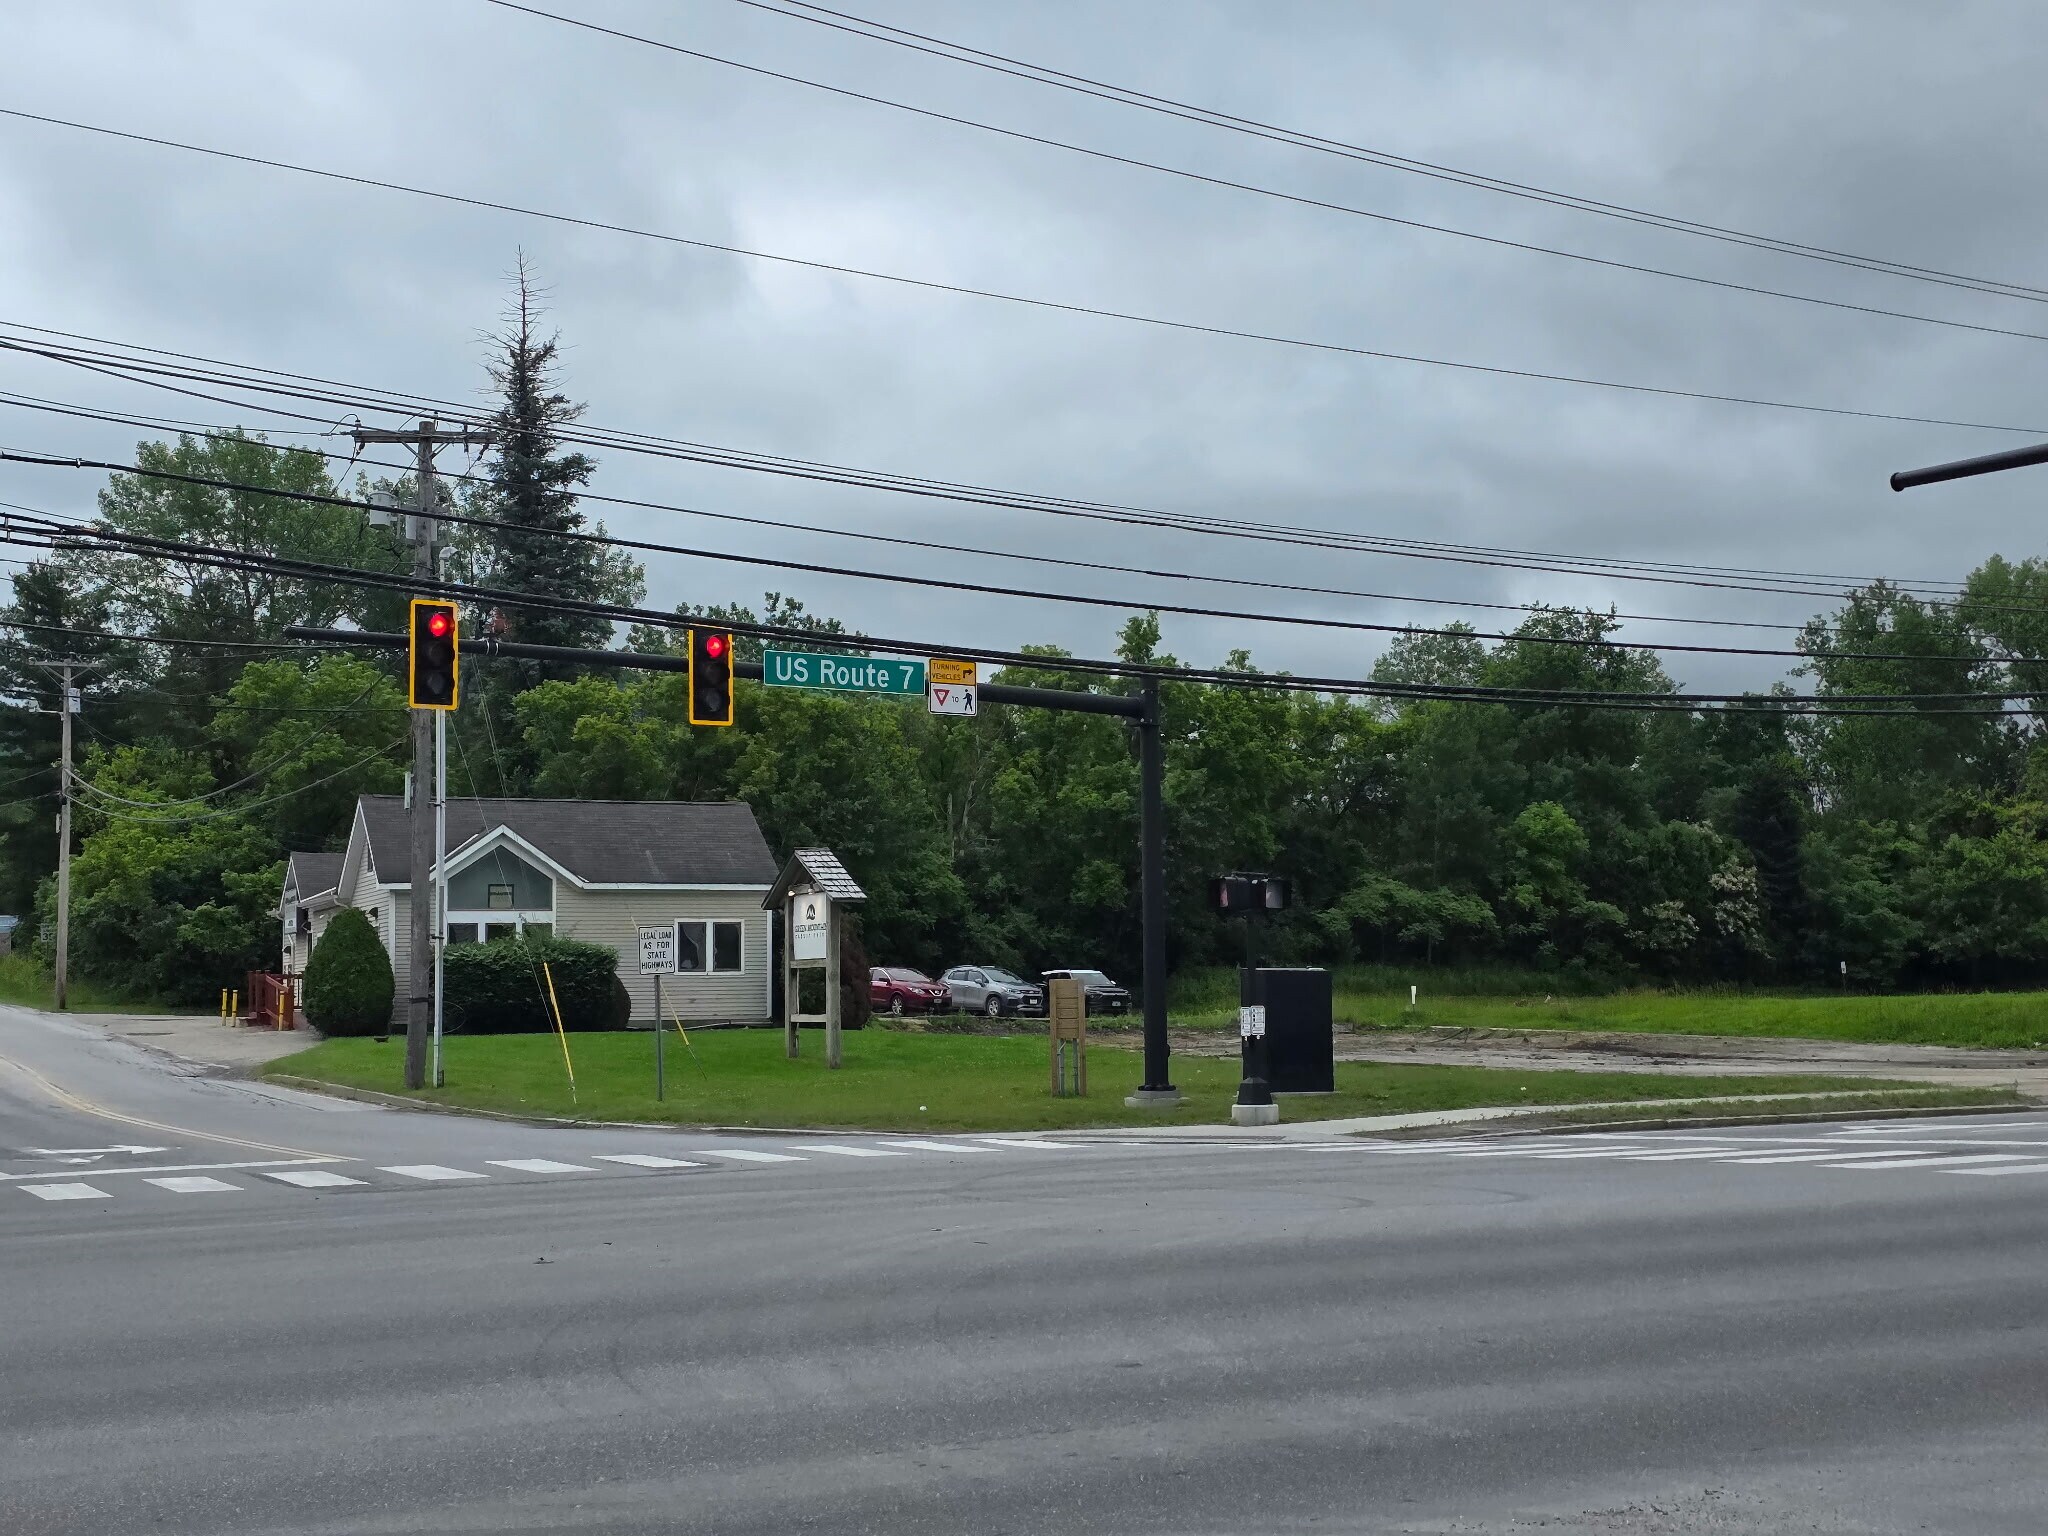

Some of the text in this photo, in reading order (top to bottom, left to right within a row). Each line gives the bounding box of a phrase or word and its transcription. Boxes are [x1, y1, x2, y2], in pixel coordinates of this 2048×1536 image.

[933, 662, 960, 671] TURNING
[775, 656, 914, 690] US Route 7
[931, 672, 961, 680] VEHICLES
[641, 931, 672, 940] LEGAL LOAD
[643, 941, 670, 949] AS FOR
[647, 951, 666, 959] STATE
[641, 960, 673, 969] HIGHWAYS
